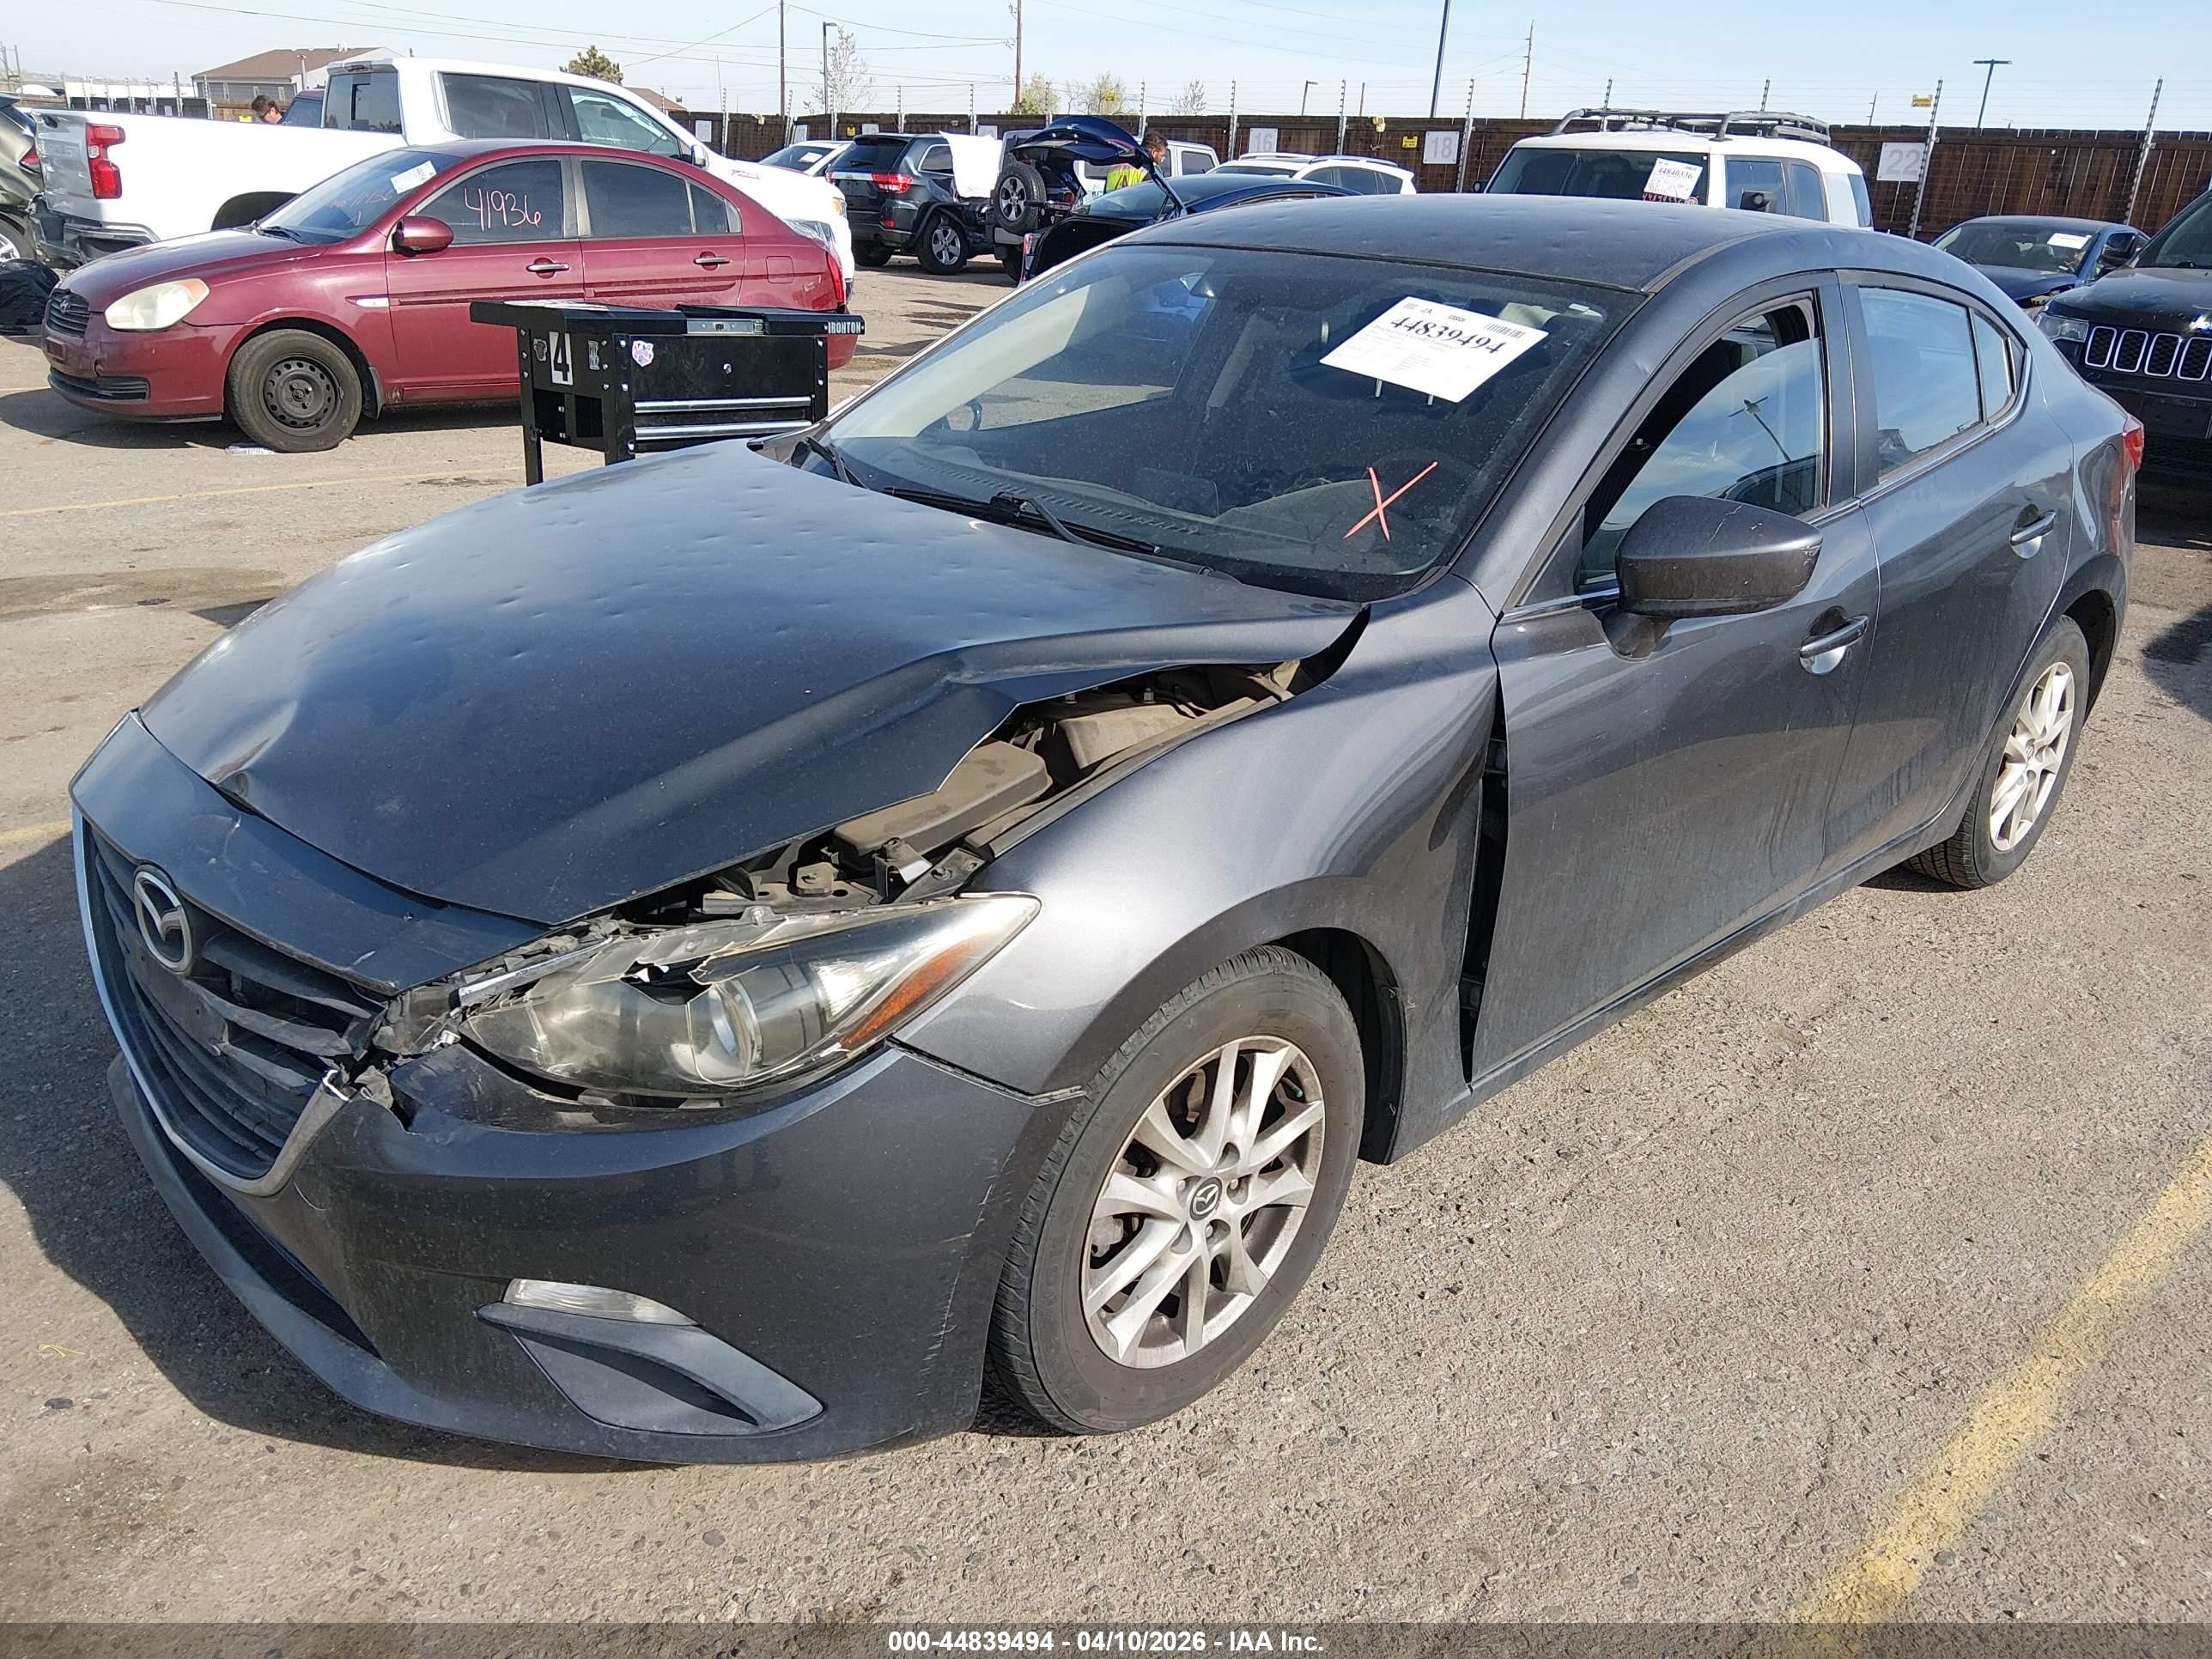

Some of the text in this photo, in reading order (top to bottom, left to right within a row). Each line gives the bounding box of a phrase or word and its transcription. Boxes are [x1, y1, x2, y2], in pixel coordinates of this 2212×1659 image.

[1254, 132, 1273, 153] 16
[1431, 137, 1452, 158] 18
[1886, 148, 1921, 174] 22
[464, 186, 542, 232] 41936
[828, 321, 861, 334] IRONTON
[1390, 316, 1507, 354] 44839494
[554, 331, 570, 381] 4
